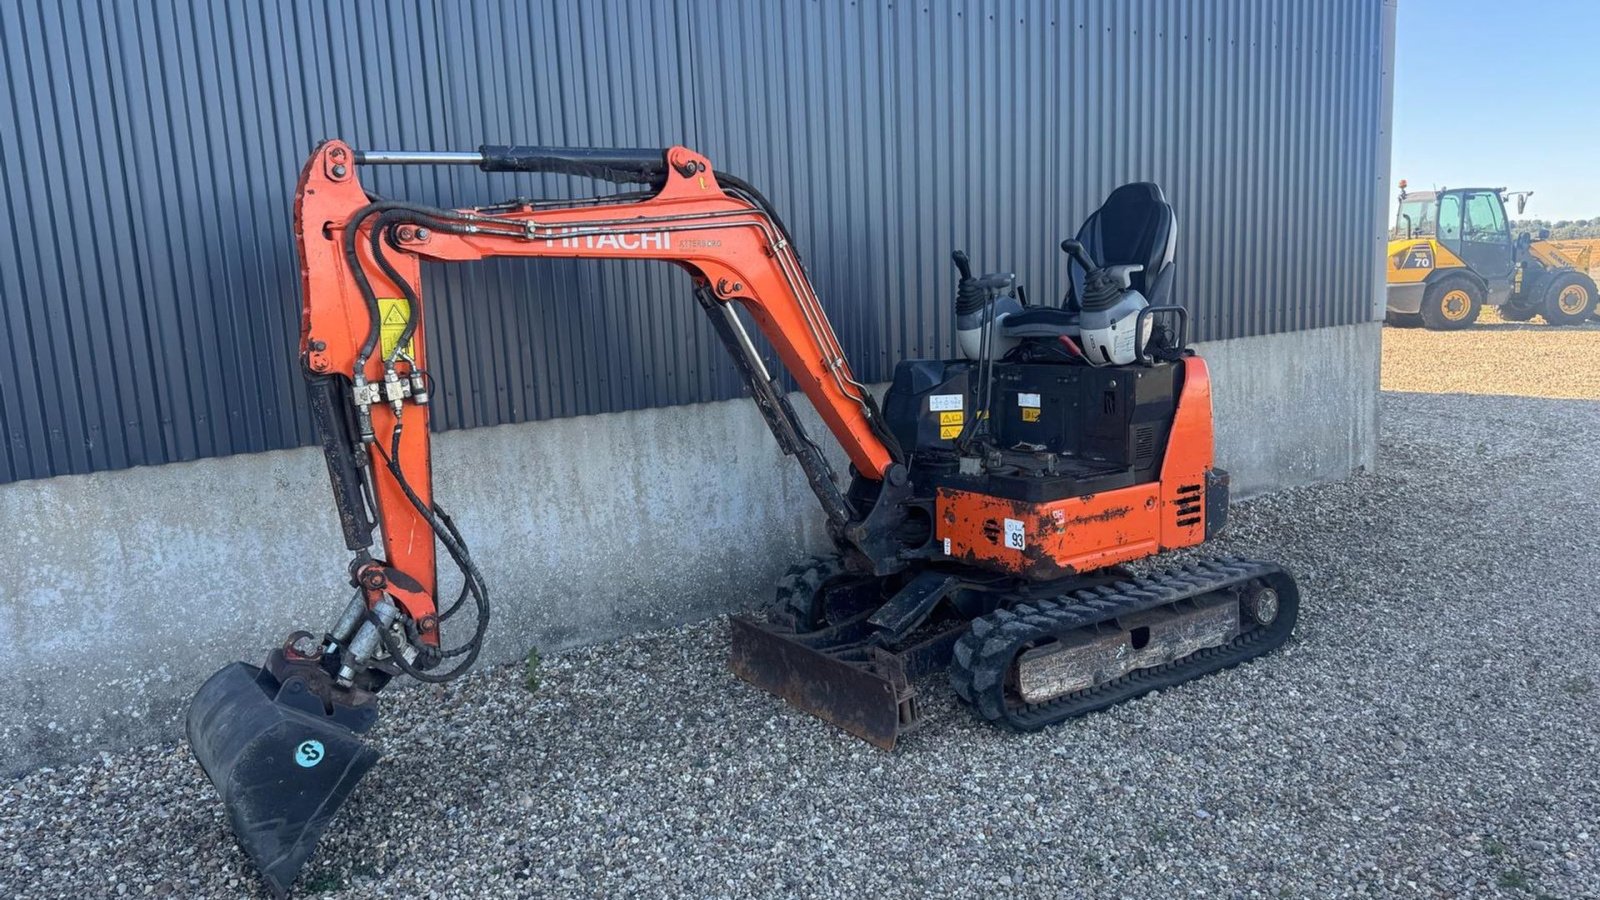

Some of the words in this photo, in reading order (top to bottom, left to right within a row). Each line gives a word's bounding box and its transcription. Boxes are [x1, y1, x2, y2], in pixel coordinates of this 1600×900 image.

[546, 227, 671, 249] HITACHI
[1414, 258, 1429, 267] 70
[1012, 532, 1023, 548] 93
